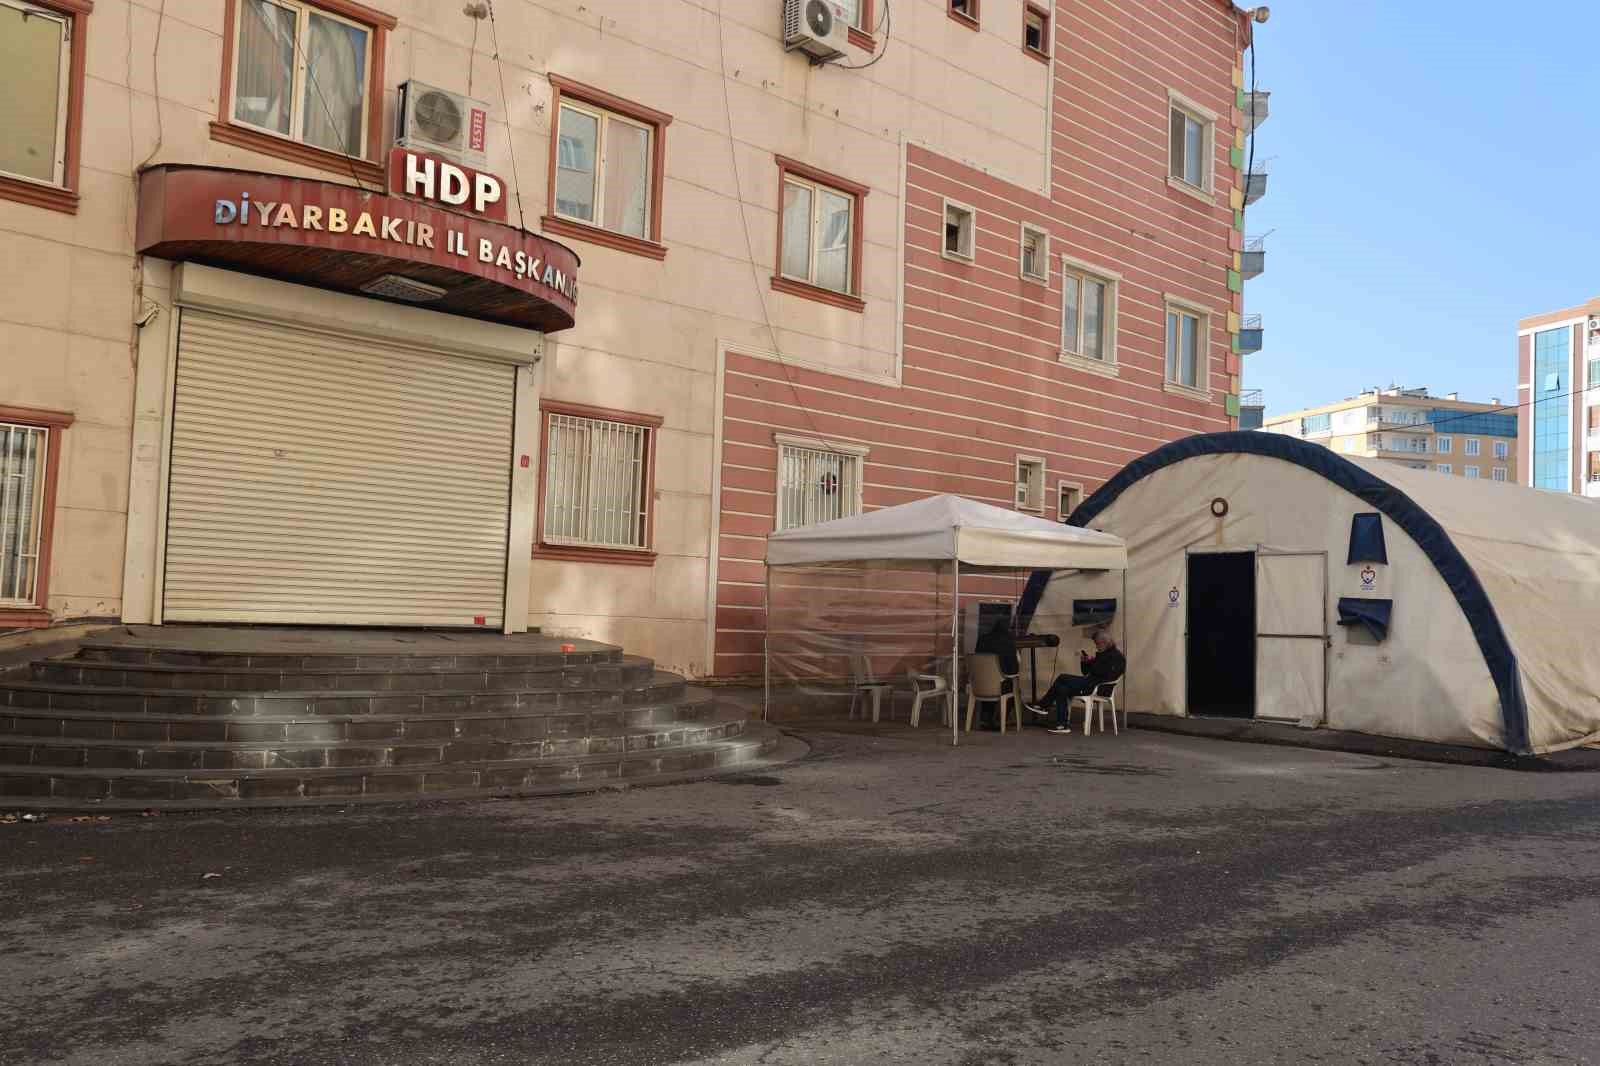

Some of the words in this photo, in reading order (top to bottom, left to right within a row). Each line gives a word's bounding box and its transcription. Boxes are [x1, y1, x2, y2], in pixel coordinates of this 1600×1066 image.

[472, 111, 484, 149] VESTEL
[406, 153, 501, 212] HDP
[215, 191, 434, 248] DİYARBAKIR
